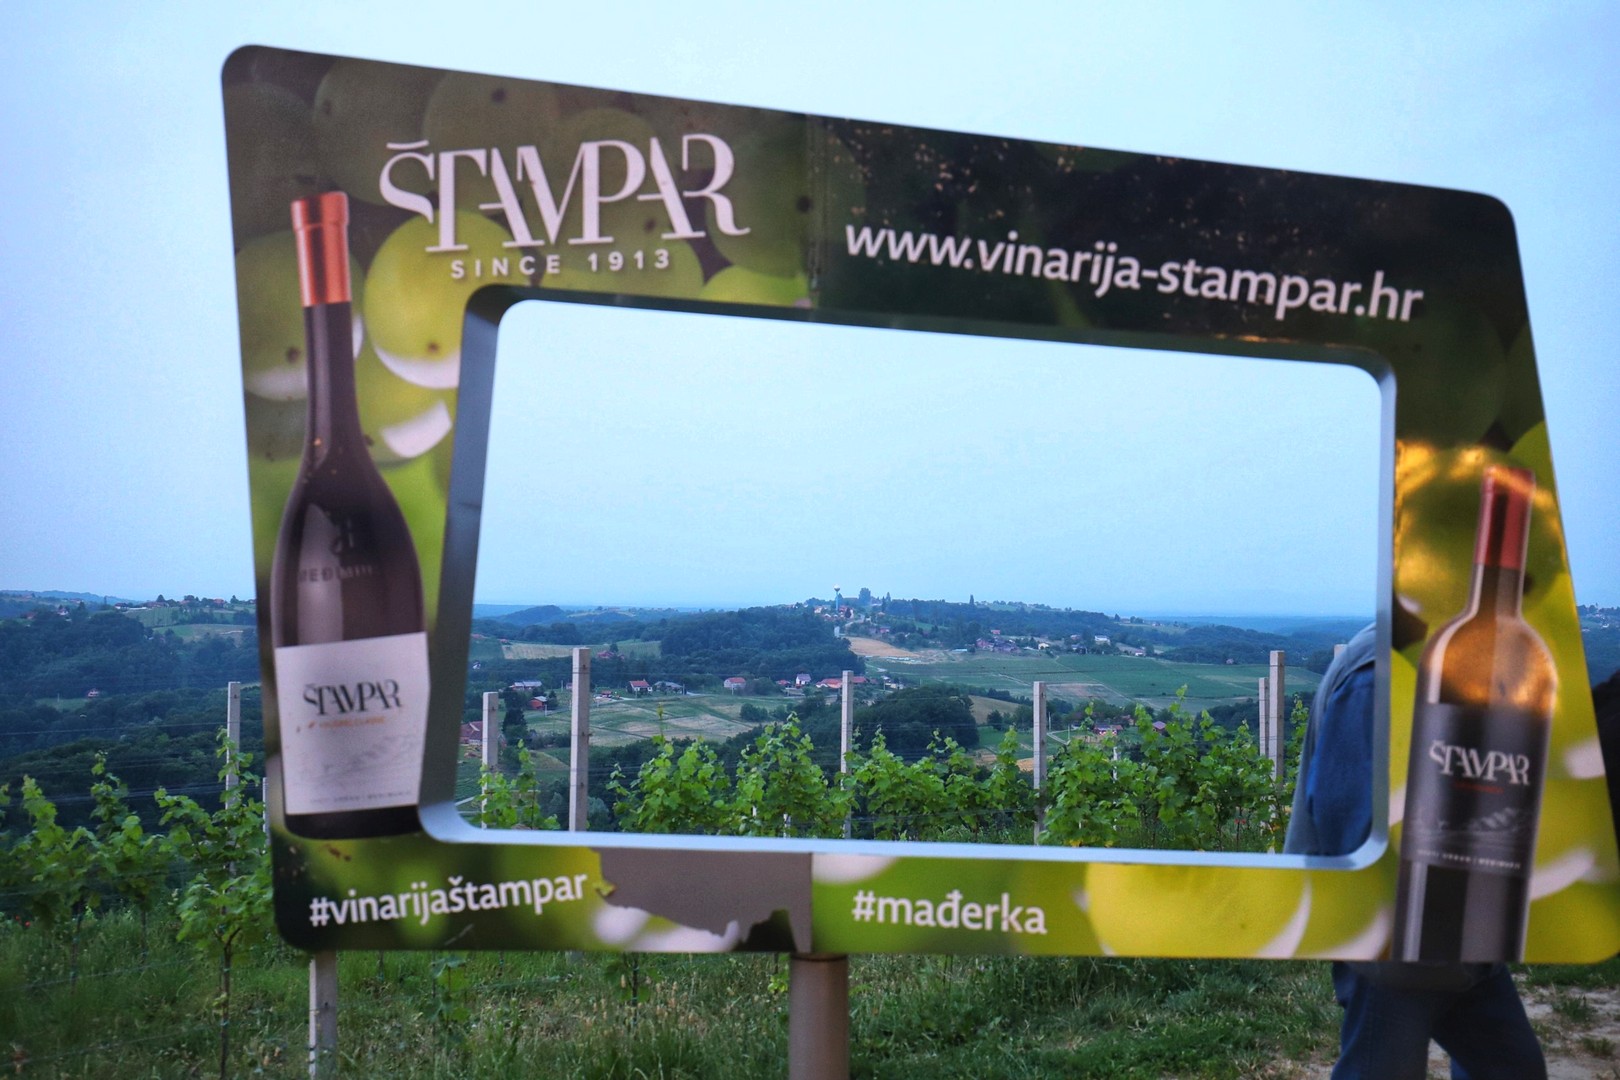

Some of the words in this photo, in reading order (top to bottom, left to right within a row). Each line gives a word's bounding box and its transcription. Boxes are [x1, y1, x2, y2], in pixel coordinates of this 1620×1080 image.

[450, 254, 561, 279] SINCE
[587, 248, 670, 272] 1913
[845, 223, 1423, 321] www.vinarija-stampar.hr
[309, 873, 588, 927] #vinarijaštampar
[851, 888, 1048, 935] #mađerka
